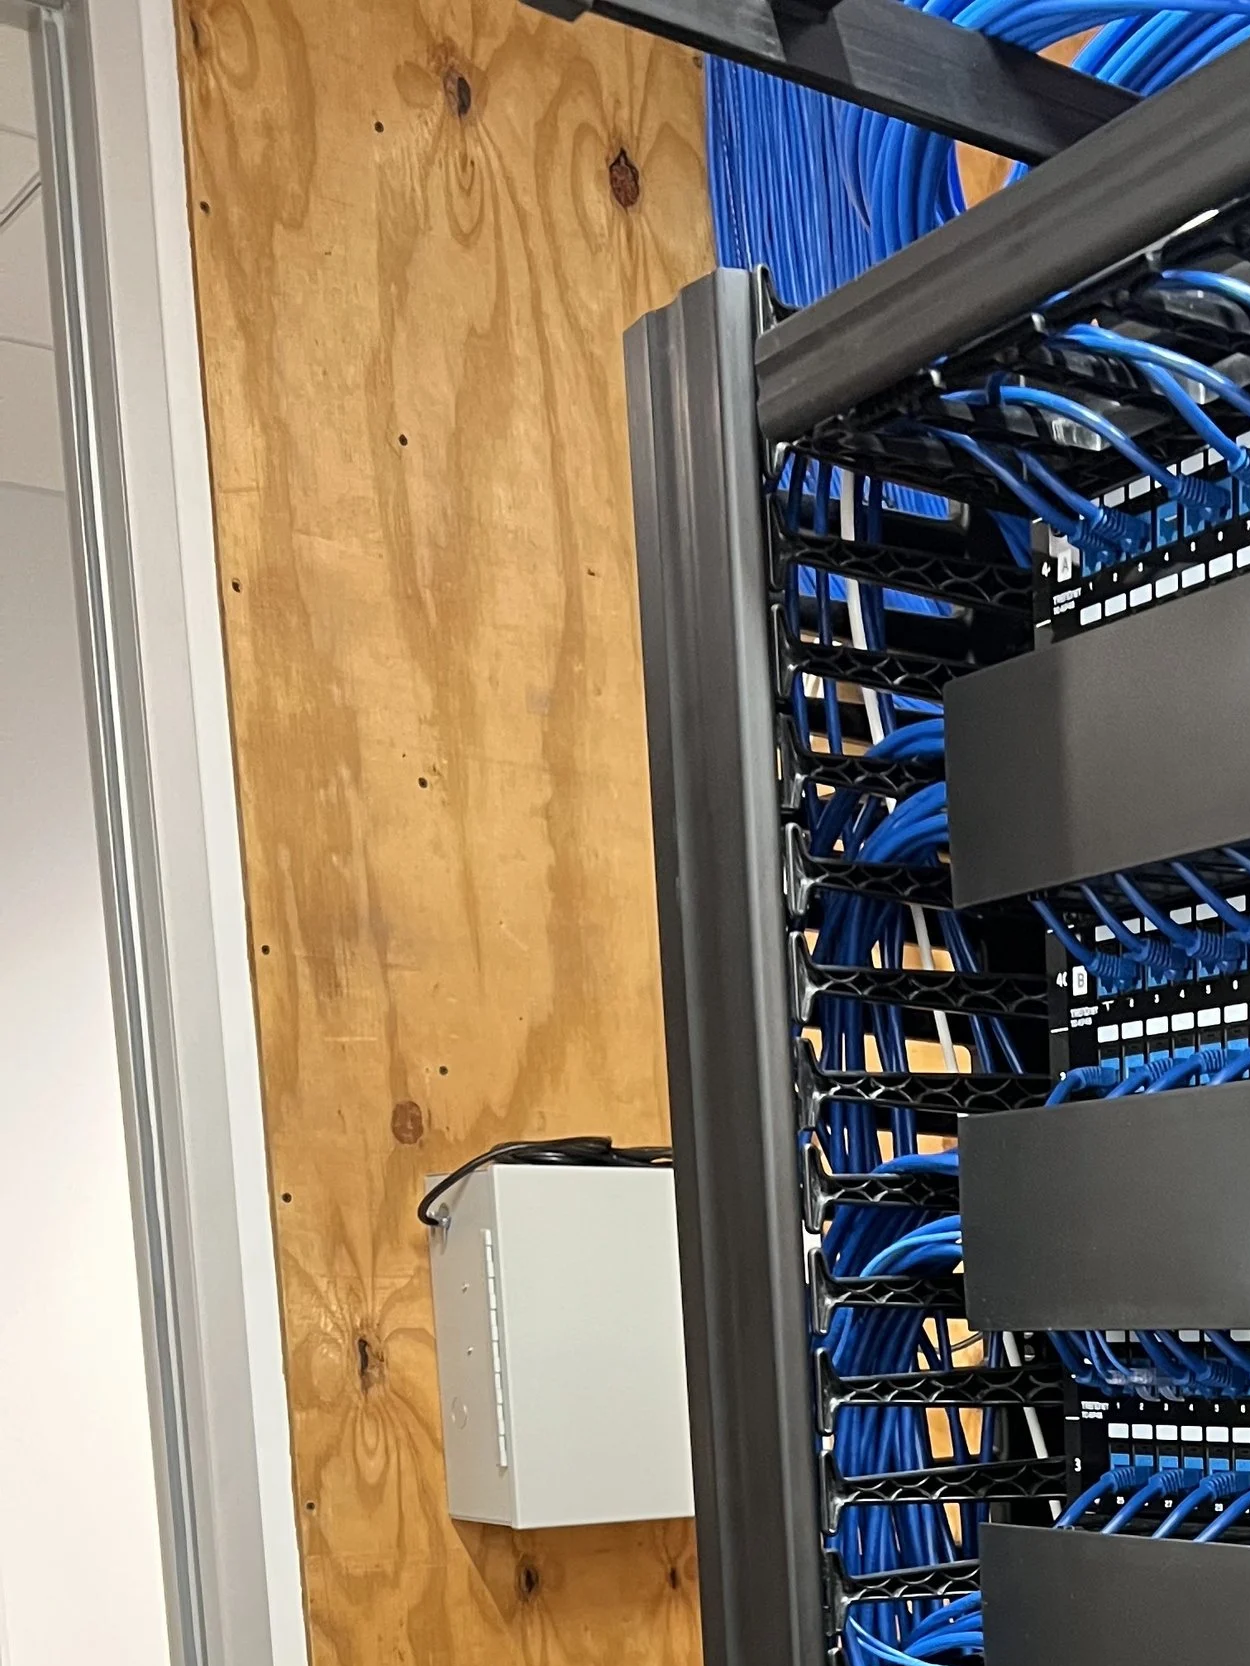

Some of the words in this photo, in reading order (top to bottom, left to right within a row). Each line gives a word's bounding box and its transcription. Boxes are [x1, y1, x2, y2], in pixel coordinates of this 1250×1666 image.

[1062, 555, 1070, 571] A
[1077, 972, 1085, 988] B
[1179, 988, 1186, 999] 4
[1116, 1401, 1121, 1410] 1
[1139, 1402, 1145, 1411] 2
[1188, 1403, 1194, 1412] 4
[1240, 1404, 1246, 1414] 6
